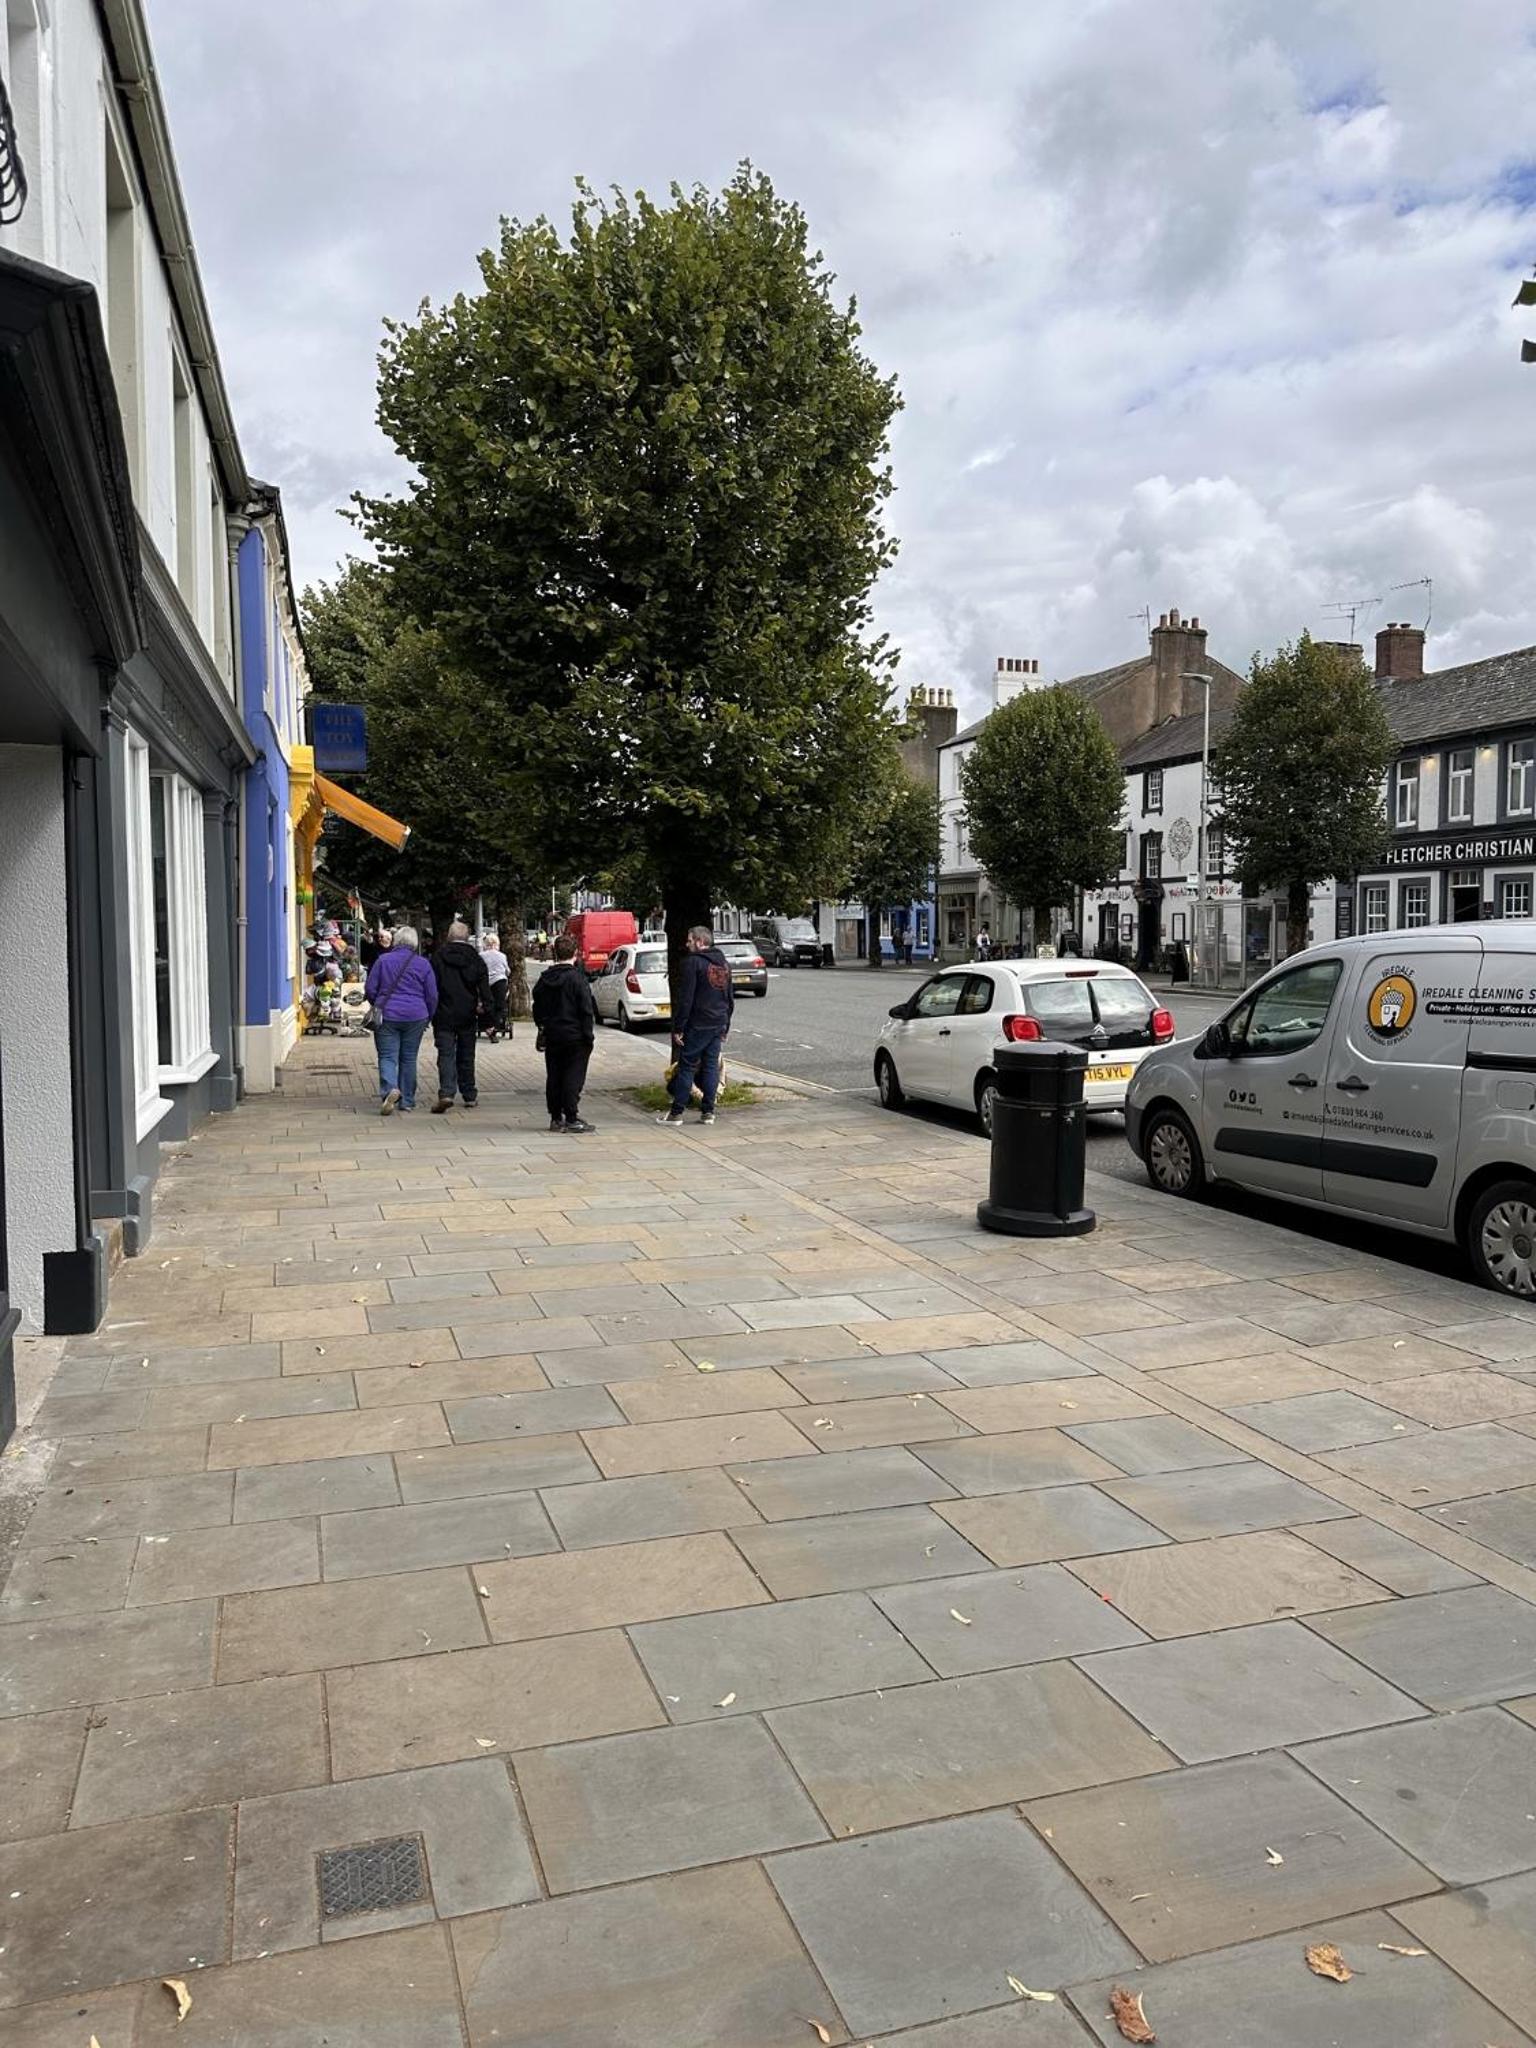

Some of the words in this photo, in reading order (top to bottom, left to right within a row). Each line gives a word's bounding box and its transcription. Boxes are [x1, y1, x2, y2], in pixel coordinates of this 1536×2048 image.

[1386, 844, 1452, 864] FLETCHER
[1455, 837, 1533, 860] CHRISTIAN
[1422, 987, 1464, 999] IREDALE
[1468, 987, 1524, 1000] CLEANING
[1428, 1004, 1451, 1013] Private
[1455, 1004, 1479, 1014] Holiday
[1480, 1004, 1495, 1013] Lets
[1500, 1005, 1520, 1014] Office
[1520, 1005, 1527, 1014] &
[1105, 1066, 1127, 1078] VYL
